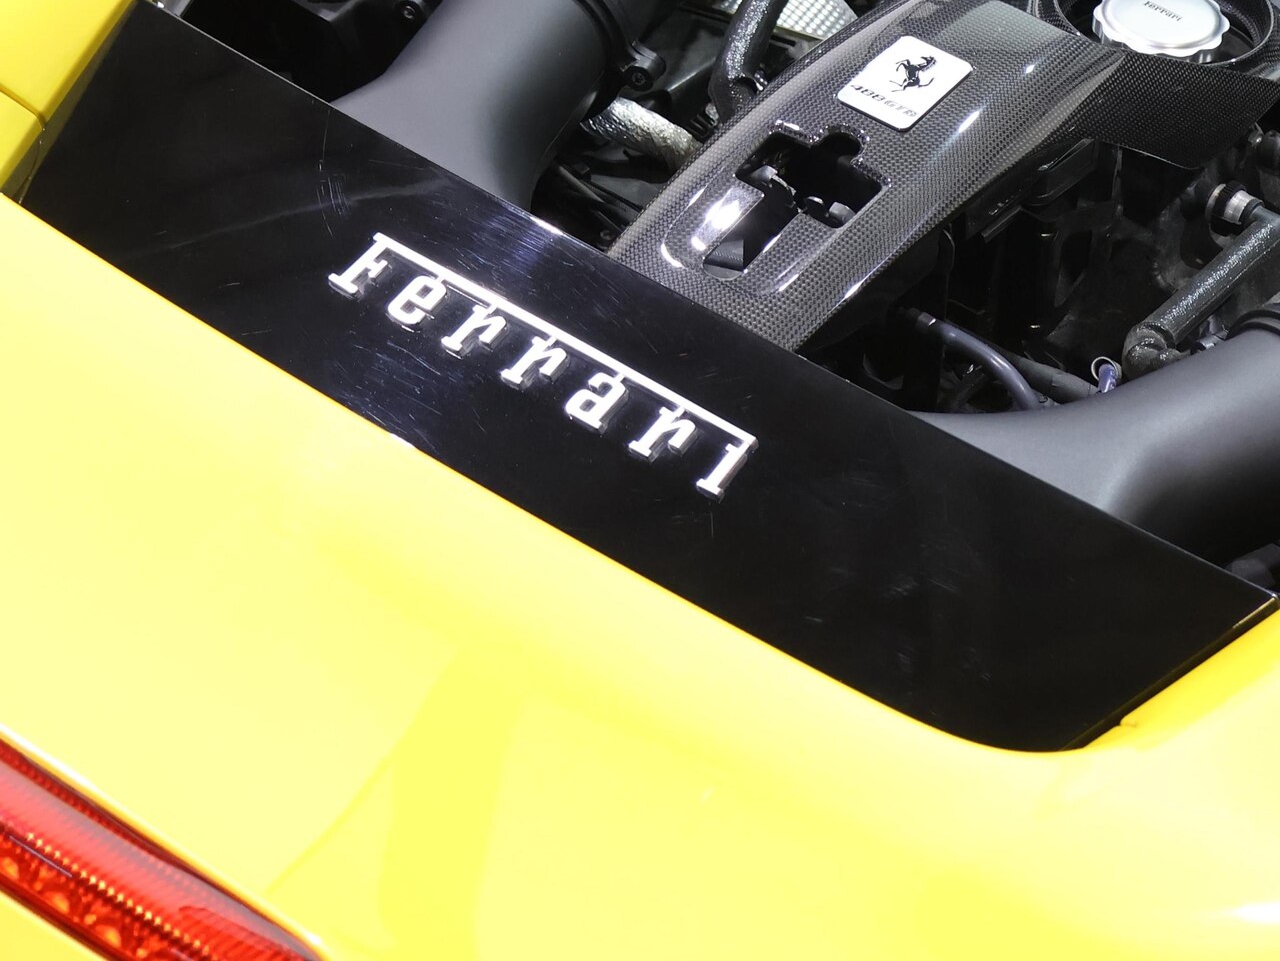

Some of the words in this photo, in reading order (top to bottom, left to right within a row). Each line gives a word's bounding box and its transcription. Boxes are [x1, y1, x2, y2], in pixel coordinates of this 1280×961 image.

[1143, 0, 1183, 22] Ferrari
[850, 84, 886, 102] 488
[328, 231, 759, 503] Ferrari
